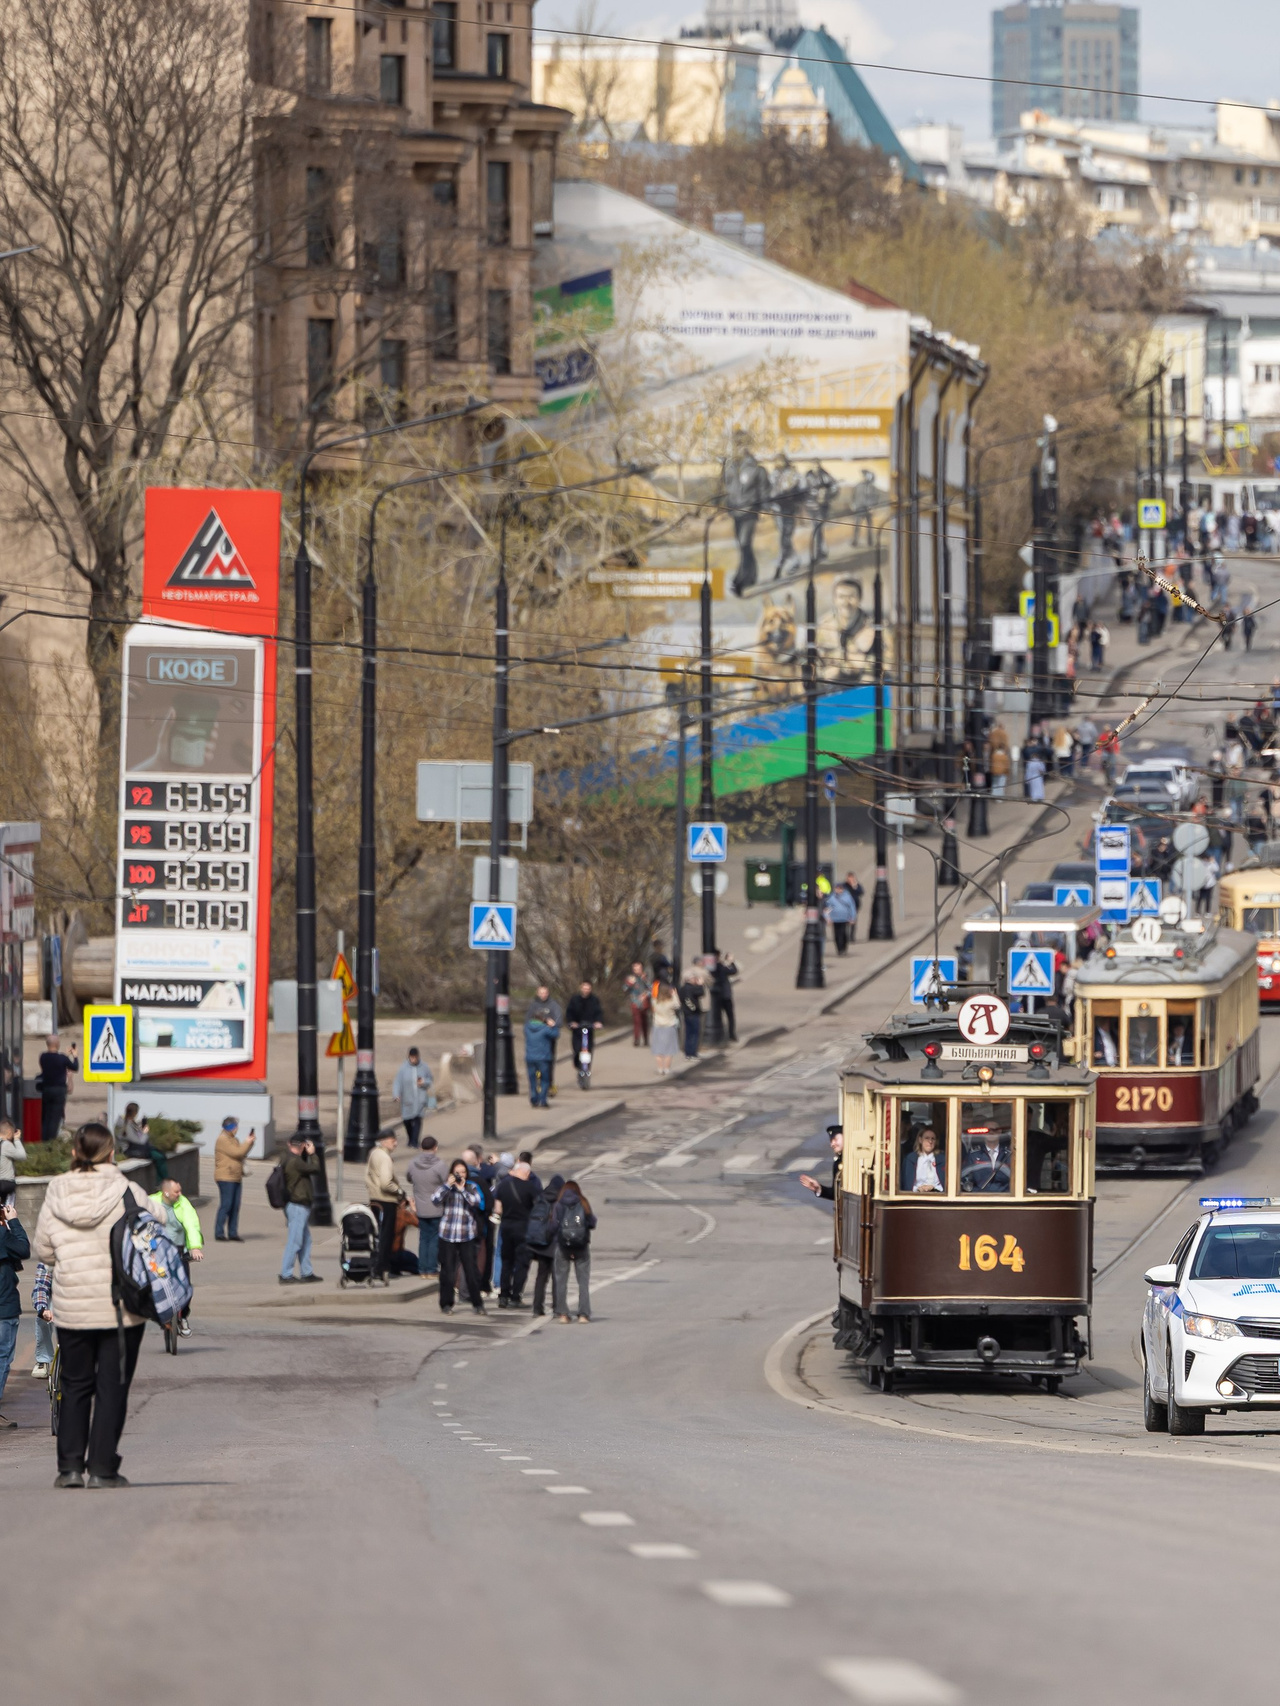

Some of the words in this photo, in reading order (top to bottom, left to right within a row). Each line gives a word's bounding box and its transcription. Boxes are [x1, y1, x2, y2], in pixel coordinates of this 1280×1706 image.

[162, 589, 260, 603] НЕФТЬМАГИСТРАЛЬ
[159, 659, 225, 681] КОФЕ
[131, 787, 153, 806] 92
[130, 826, 152, 844] 95
[128, 865, 156, 884] 100
[165, 900, 244, 931] 78.09
[125, 983, 203, 1002] МАГАЗИН
[186, 1034, 232, 1048] КОФЕ
[952, 1048, 1017, 1059] БУЛЬВАРНАЯ
[1115, 1086, 1174, 1112] 2170
[958, 1234, 1025, 1272] 164
